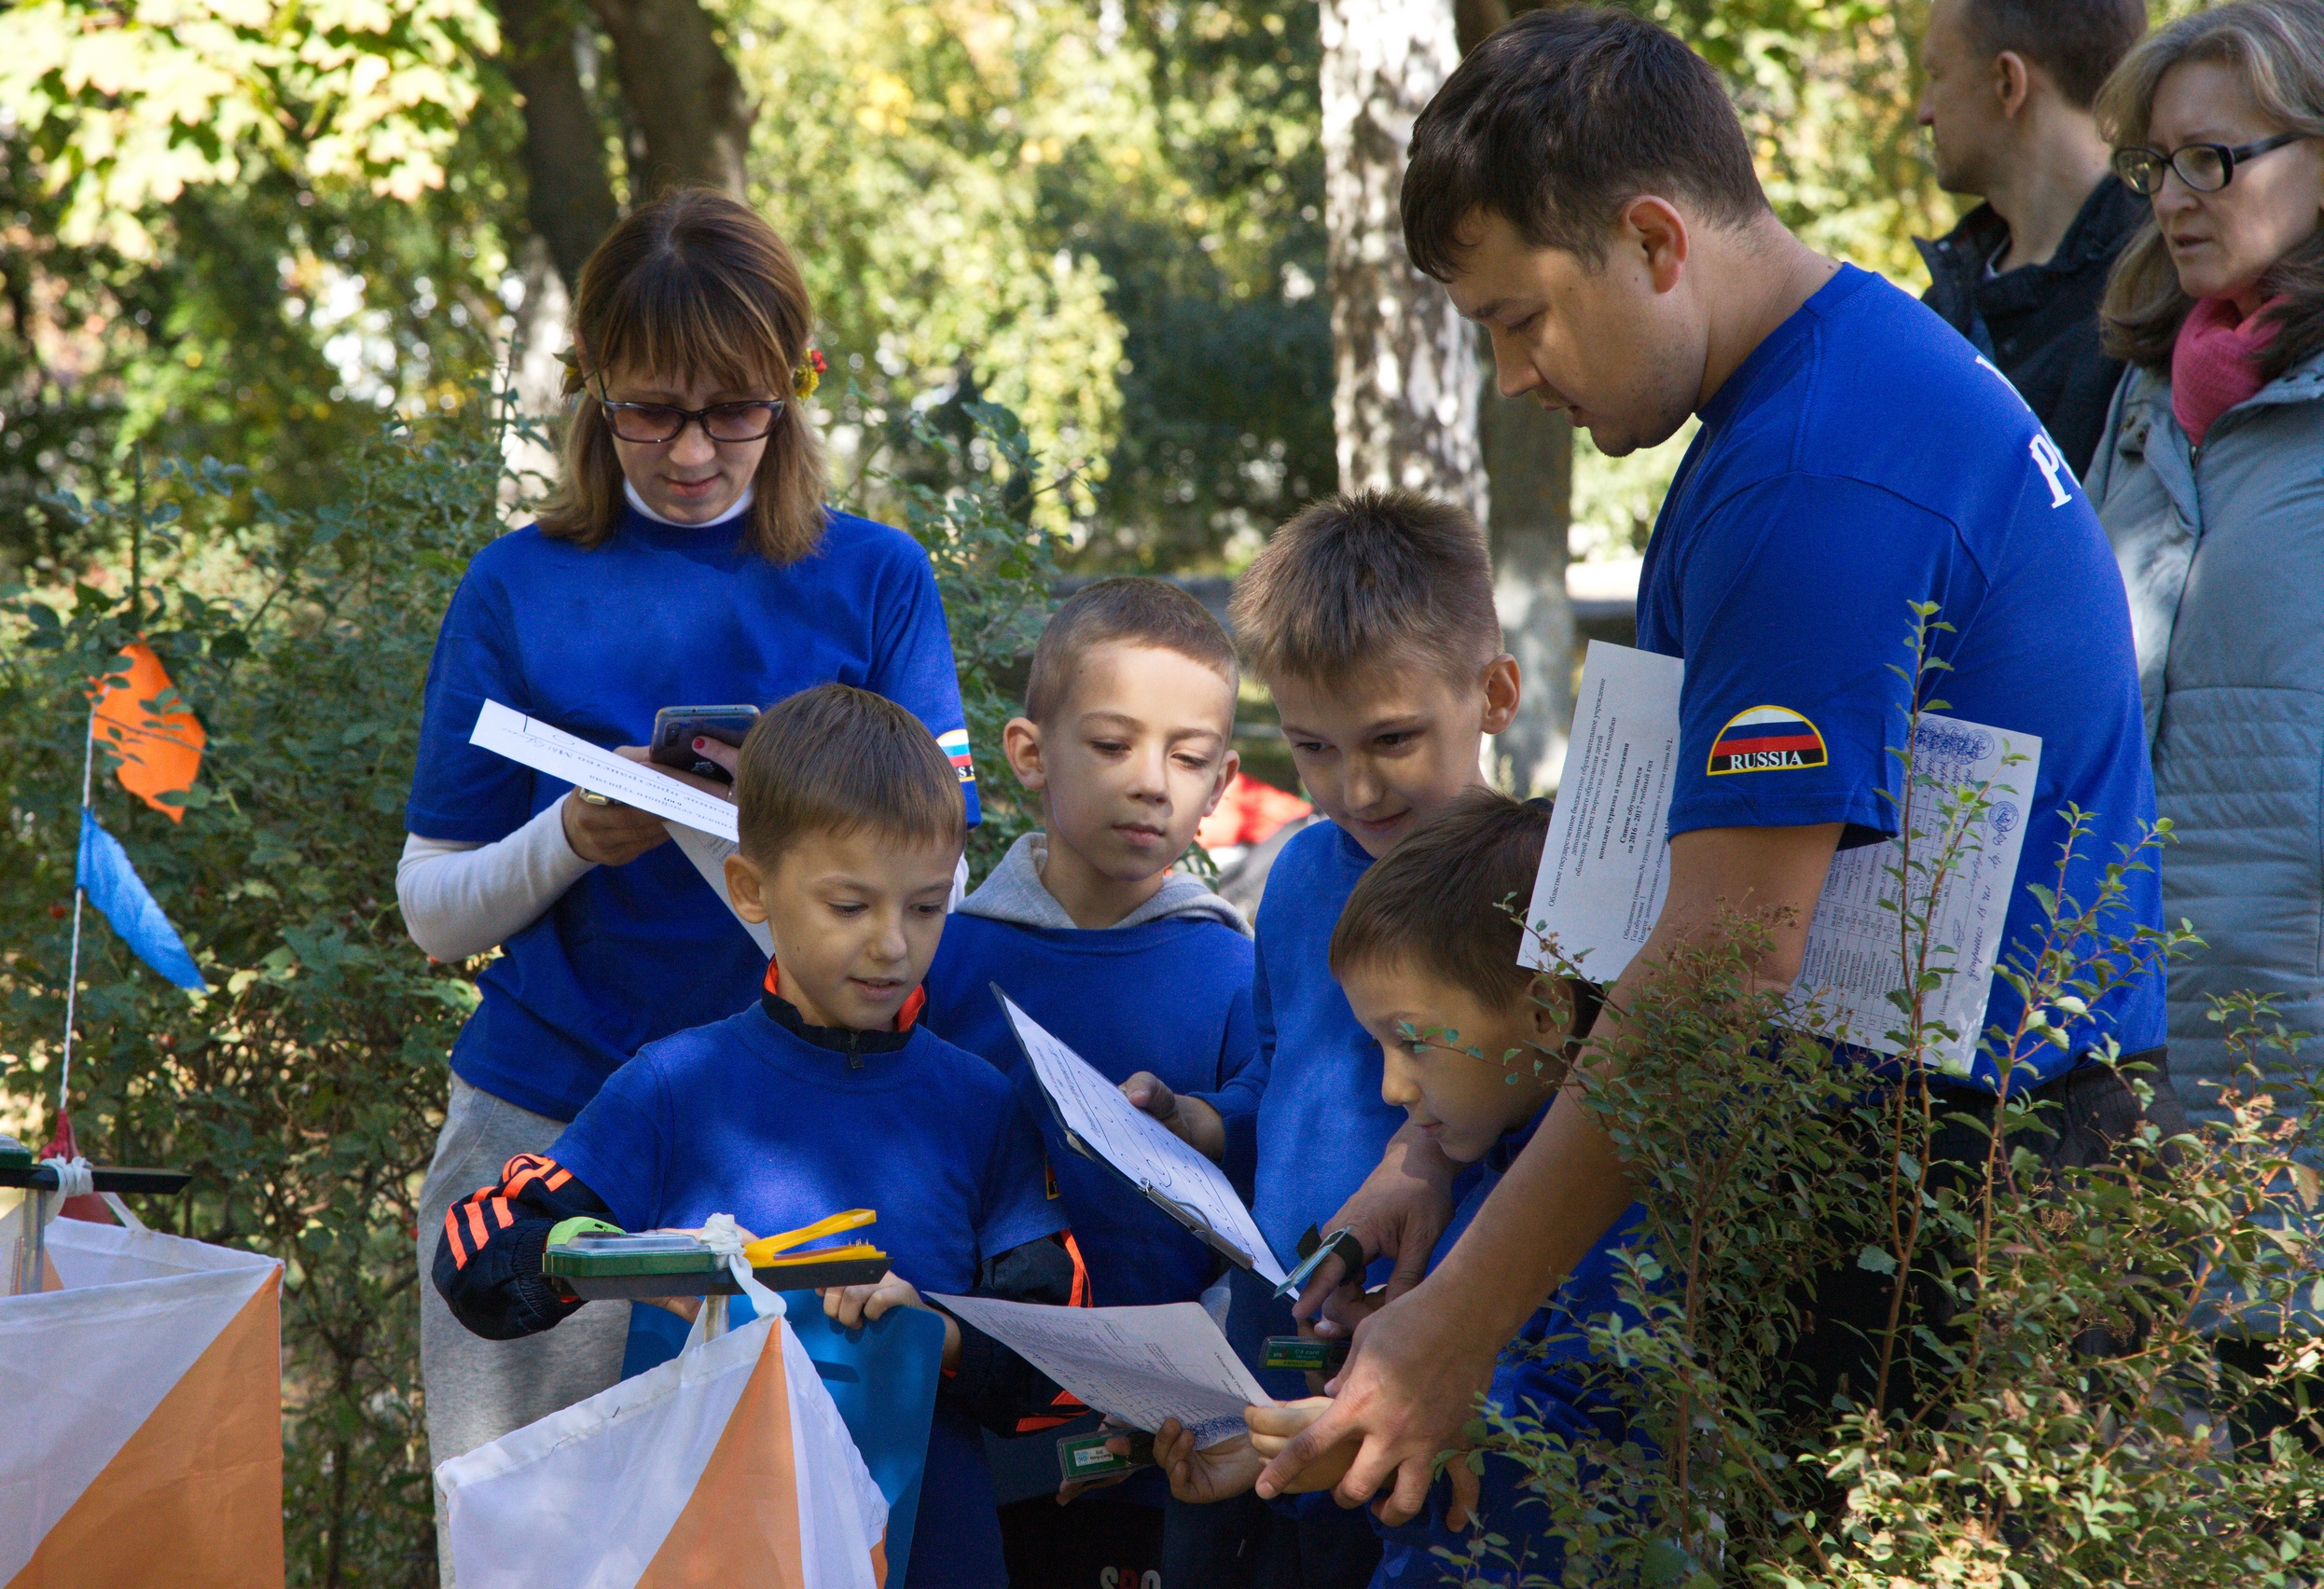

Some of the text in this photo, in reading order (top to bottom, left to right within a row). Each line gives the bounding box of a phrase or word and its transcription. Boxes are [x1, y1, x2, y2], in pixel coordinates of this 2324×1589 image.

[1730, 751, 1805, 771] RUSSIA
[1548, 678, 1605, 906] Областное государственное бюджетное образовательное учреждение
[1571, 735, 1603, 855] дополнительного образования детей
[1606, 794, 1617, 823] туризма
[1615, 742, 1629, 787] краеведения
[1639, 773, 1650, 804] учебный
[1575, 842, 1587, 876] областной
[1583, 815, 1595, 841] Дворец
[1590, 778, 1603, 814] творчества
[1599, 758, 1608, 777] детей
[1619, 767, 1642, 843] Список обучающихся
[1633, 805, 1641, 822] 2017
[1627, 845, 1633, 853] на
[1628, 827, 1637, 843] 2016
[1645, 869, 1659, 919] дополнительного
[1634, 902, 1644, 929] обучения
